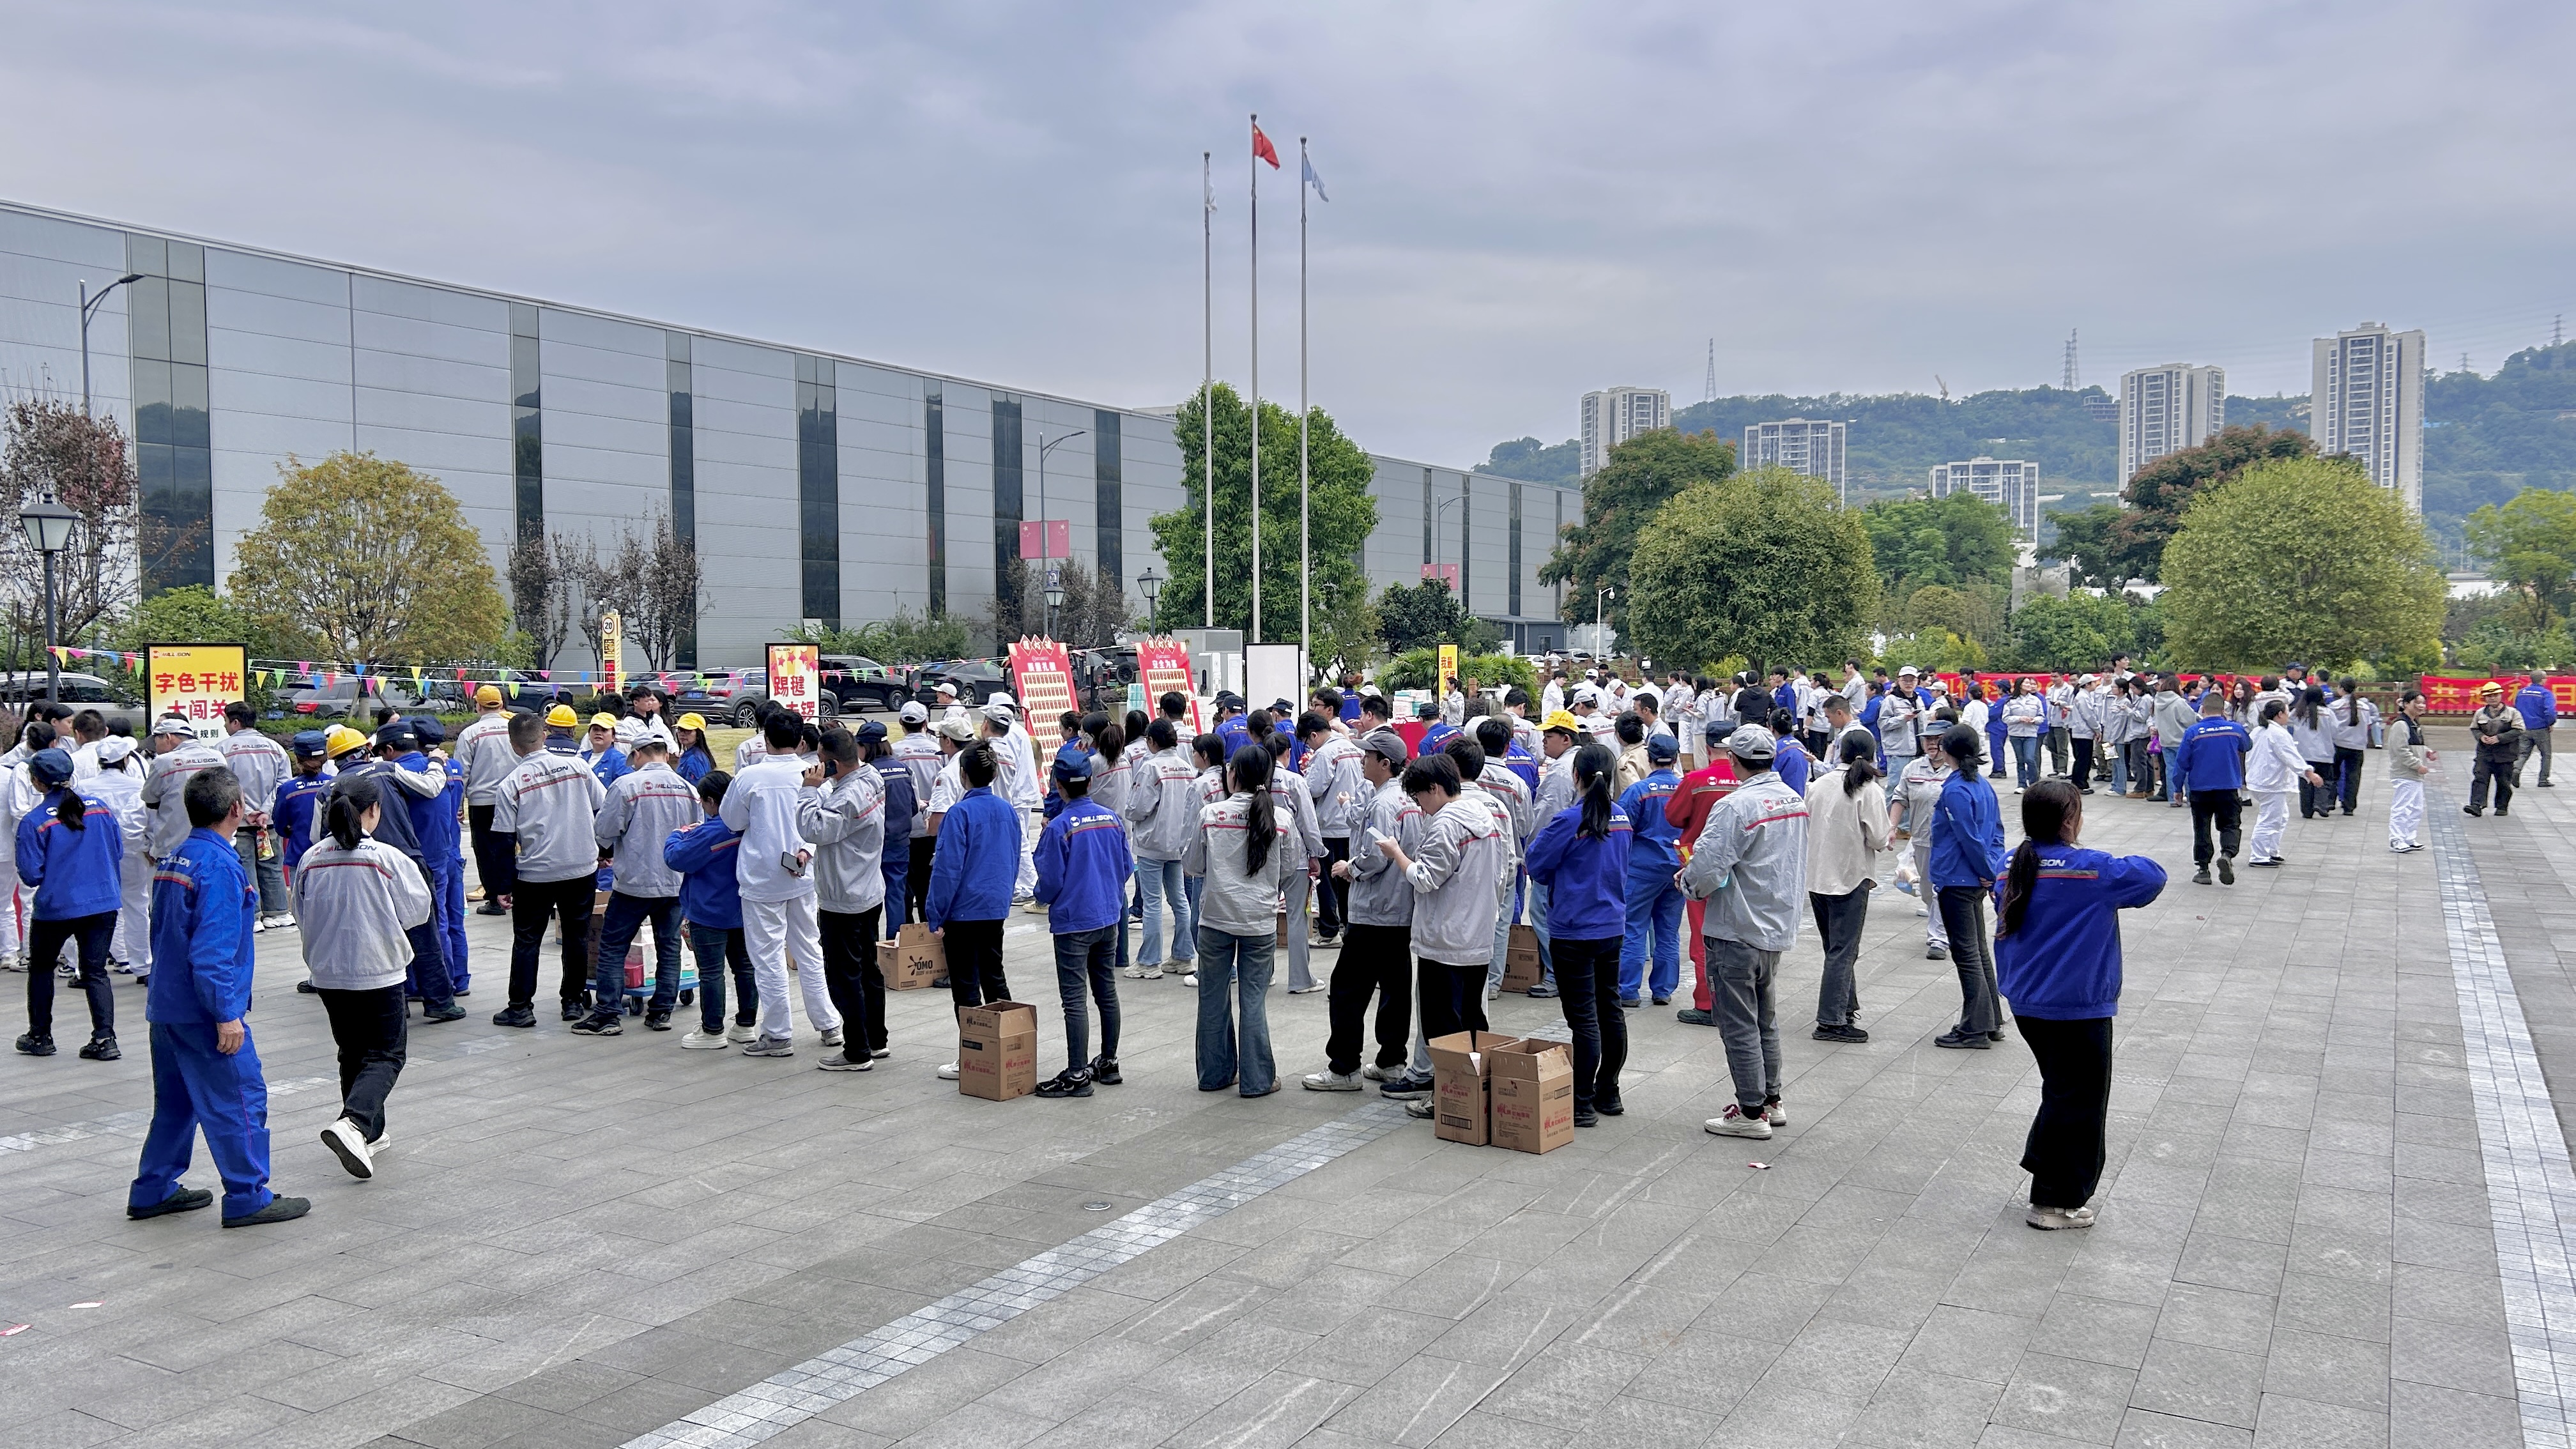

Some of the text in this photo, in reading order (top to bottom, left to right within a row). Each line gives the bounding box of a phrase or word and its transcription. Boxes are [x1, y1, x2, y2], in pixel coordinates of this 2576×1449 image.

[604, 622, 613, 630] 20
[1023, 640, 1053, 650] 猜灯谜
[155, 671, 239, 694] 字色干扰
[774, 675, 805, 697] 踢毽
[167, 699, 227, 721] 大闯关
[533, 765, 569, 778] MILLISON
[655, 783, 689, 792] MILLISON
[1082, 815, 1113, 824] MILLISON
[917, 960, 933, 970] OMO
